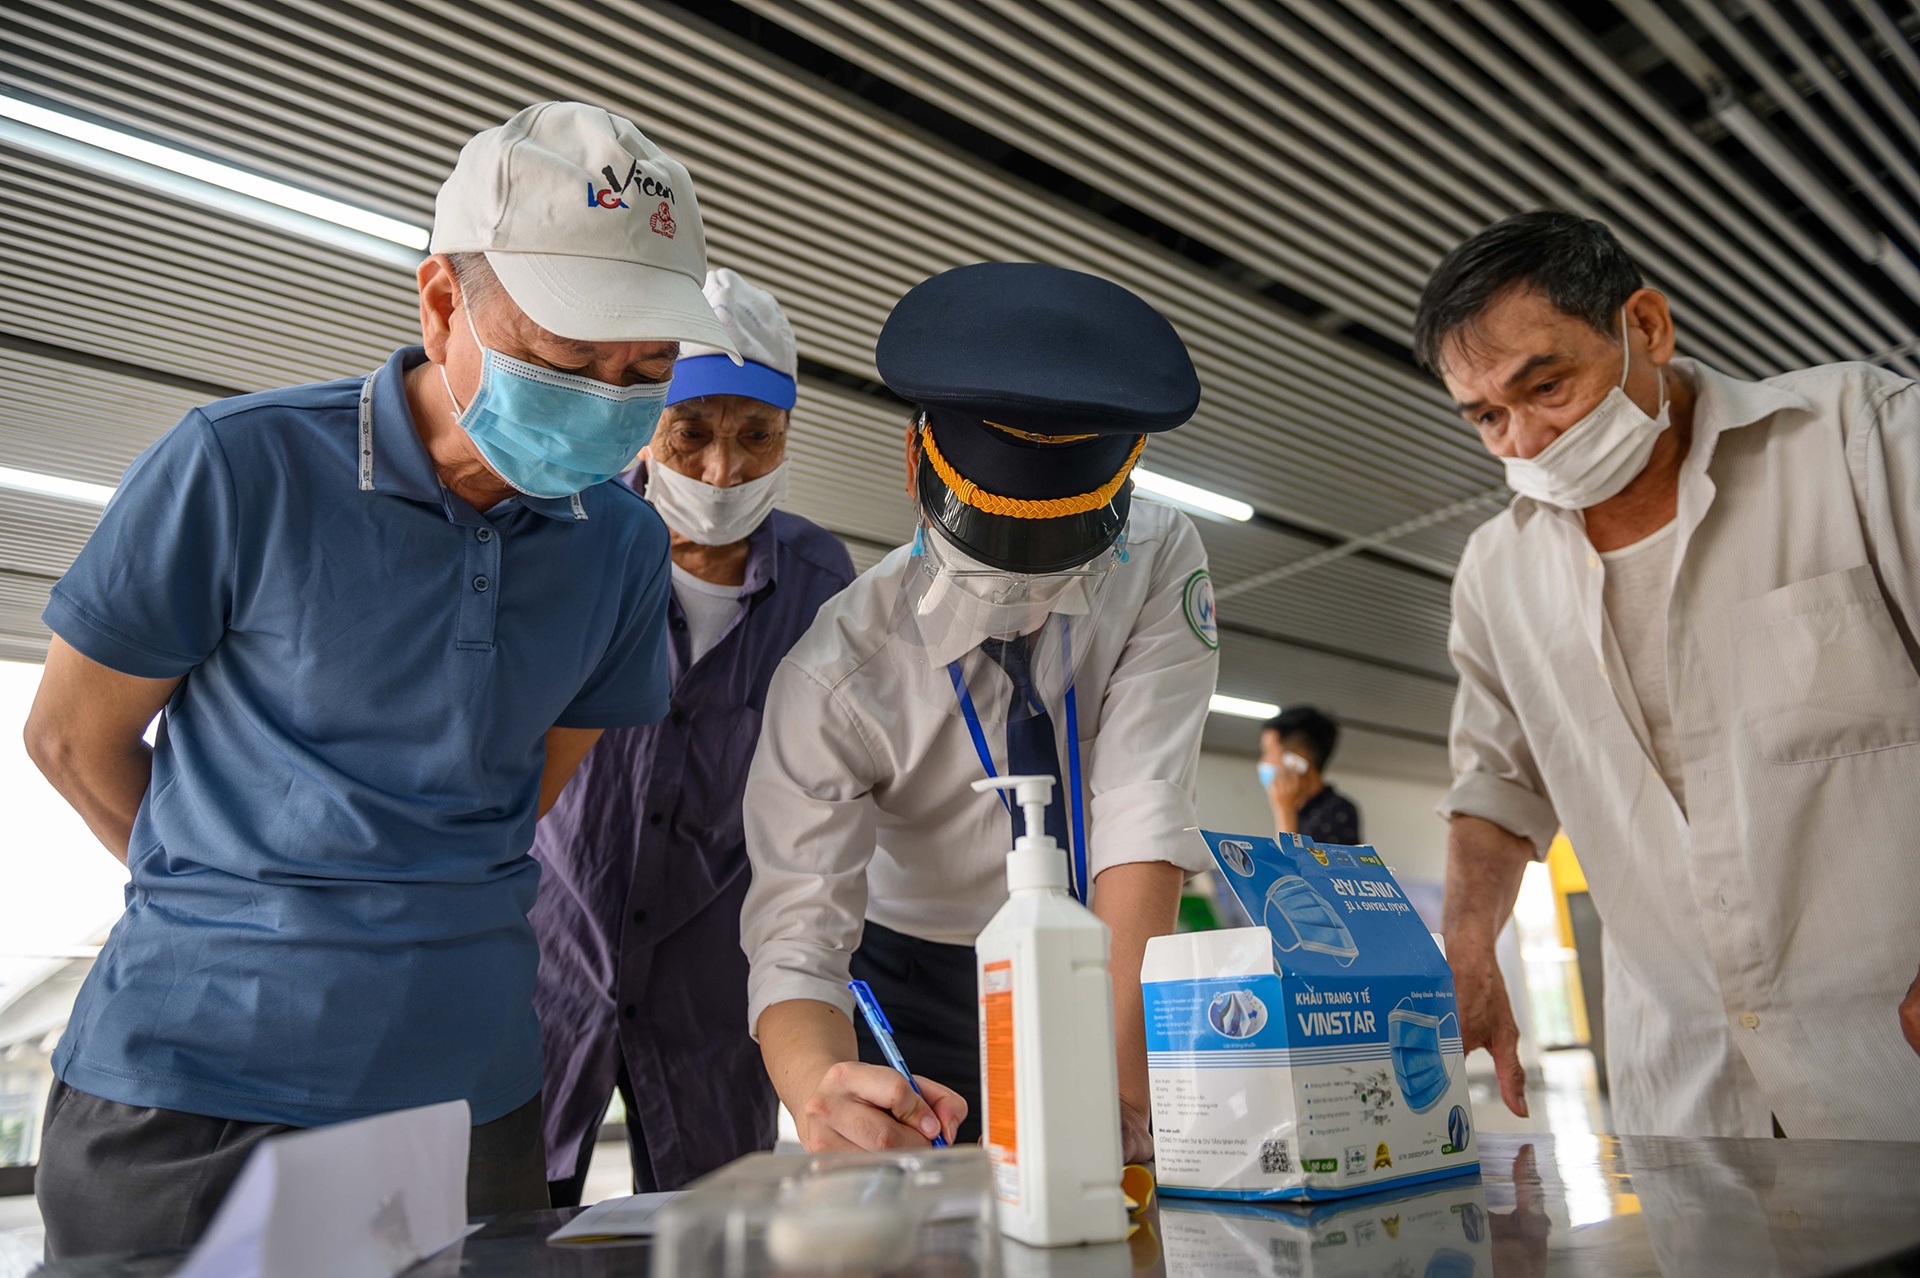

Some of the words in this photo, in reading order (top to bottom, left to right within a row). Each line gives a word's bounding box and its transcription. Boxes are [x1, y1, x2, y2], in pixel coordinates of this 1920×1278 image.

[1329, 878, 1402, 898] VINSTAR
[1344, 900, 1354, 914] TẾ
[1355, 901, 1361, 911] Y
[1361, 901, 1389, 912] TRANG
[1324, 992, 1353, 1005] TRANG
[1354, 991, 1360, 1003] Y
[1361, 986, 1371, 1004] TẾ
[1297, 1010, 1377, 1037] VINSTAR
